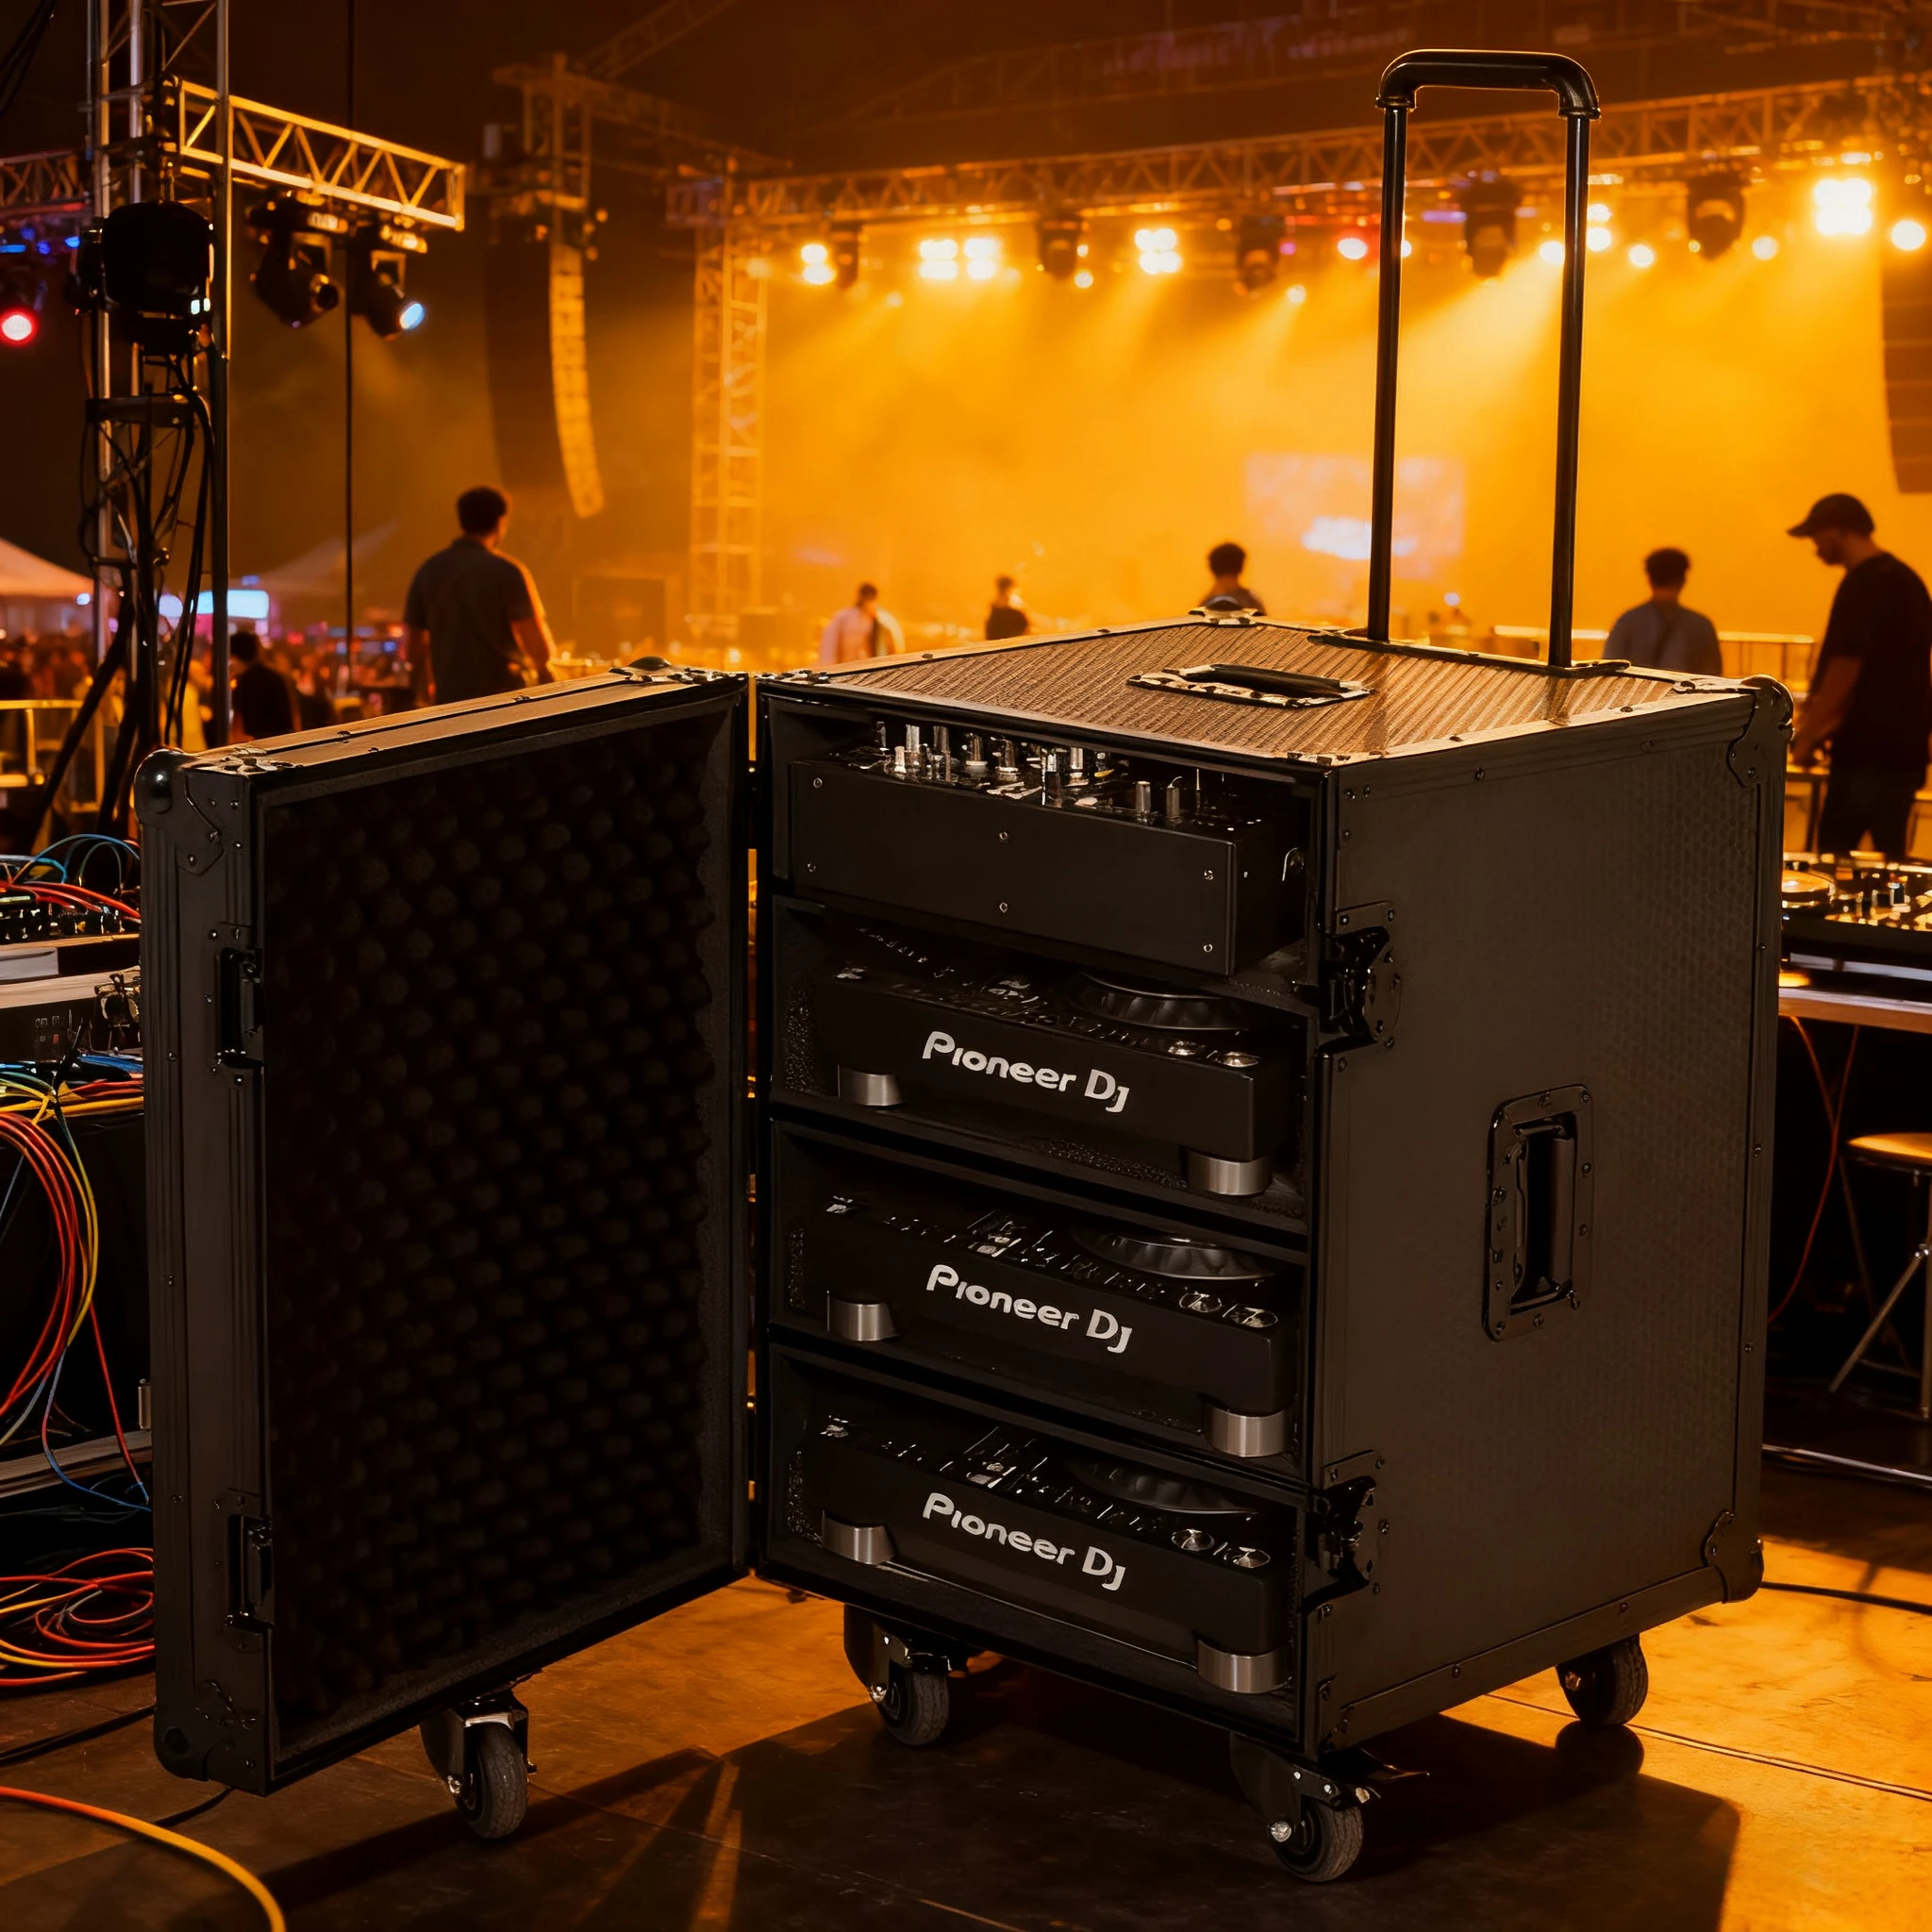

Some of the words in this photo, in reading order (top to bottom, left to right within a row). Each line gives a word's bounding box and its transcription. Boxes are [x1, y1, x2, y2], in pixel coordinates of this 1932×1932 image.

[922, 1030, 1077, 1092] Pioneer
[925, 1264, 1080, 1330] Pioneer
[922, 1492, 1075, 1565] Pioneer
